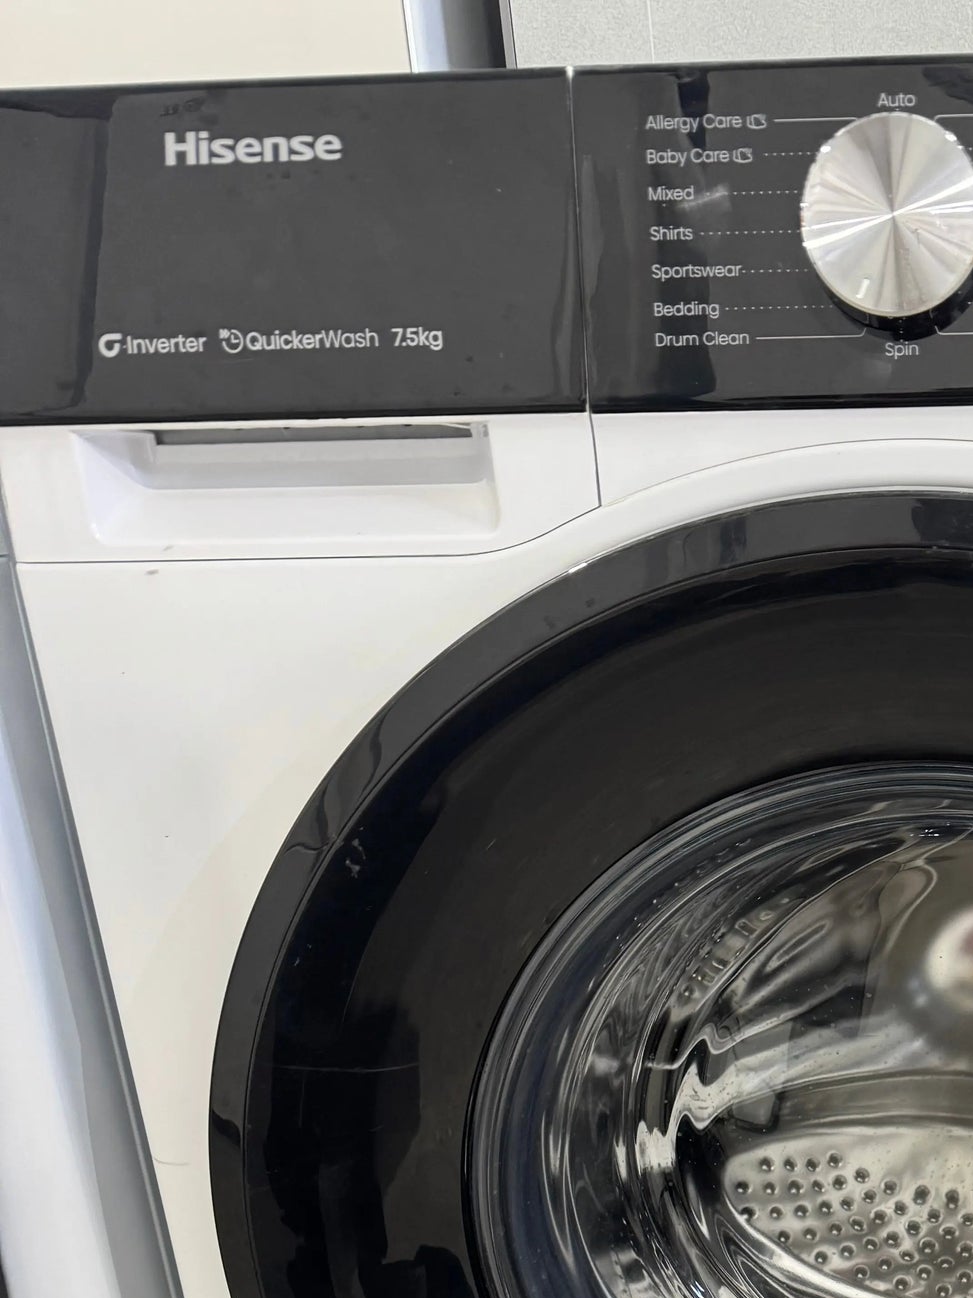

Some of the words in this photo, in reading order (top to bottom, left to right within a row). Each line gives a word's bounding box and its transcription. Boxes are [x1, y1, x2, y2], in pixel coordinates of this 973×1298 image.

[877, 93, 916, 107] Auto
[645, 114, 700, 133] Allergy
[703, 113, 743, 129] Care
[164, 130, 343, 167] Hisense
[646, 148, 688, 167] Baby
[690, 148, 730, 163] Care
[647, 185, 695, 202] Mixed
[649, 225, 694, 241] Shirts
[651, 263, 742, 282] Sportswear
[653, 301, 720, 319] Bedding
[245, 328, 379, 352] QuickerWash
[390, 327, 444, 350] 7.5kg
[655, 332, 699, 347] Drum
[702, 331, 750, 346] Clean
[884, 341, 919, 359] Spin
